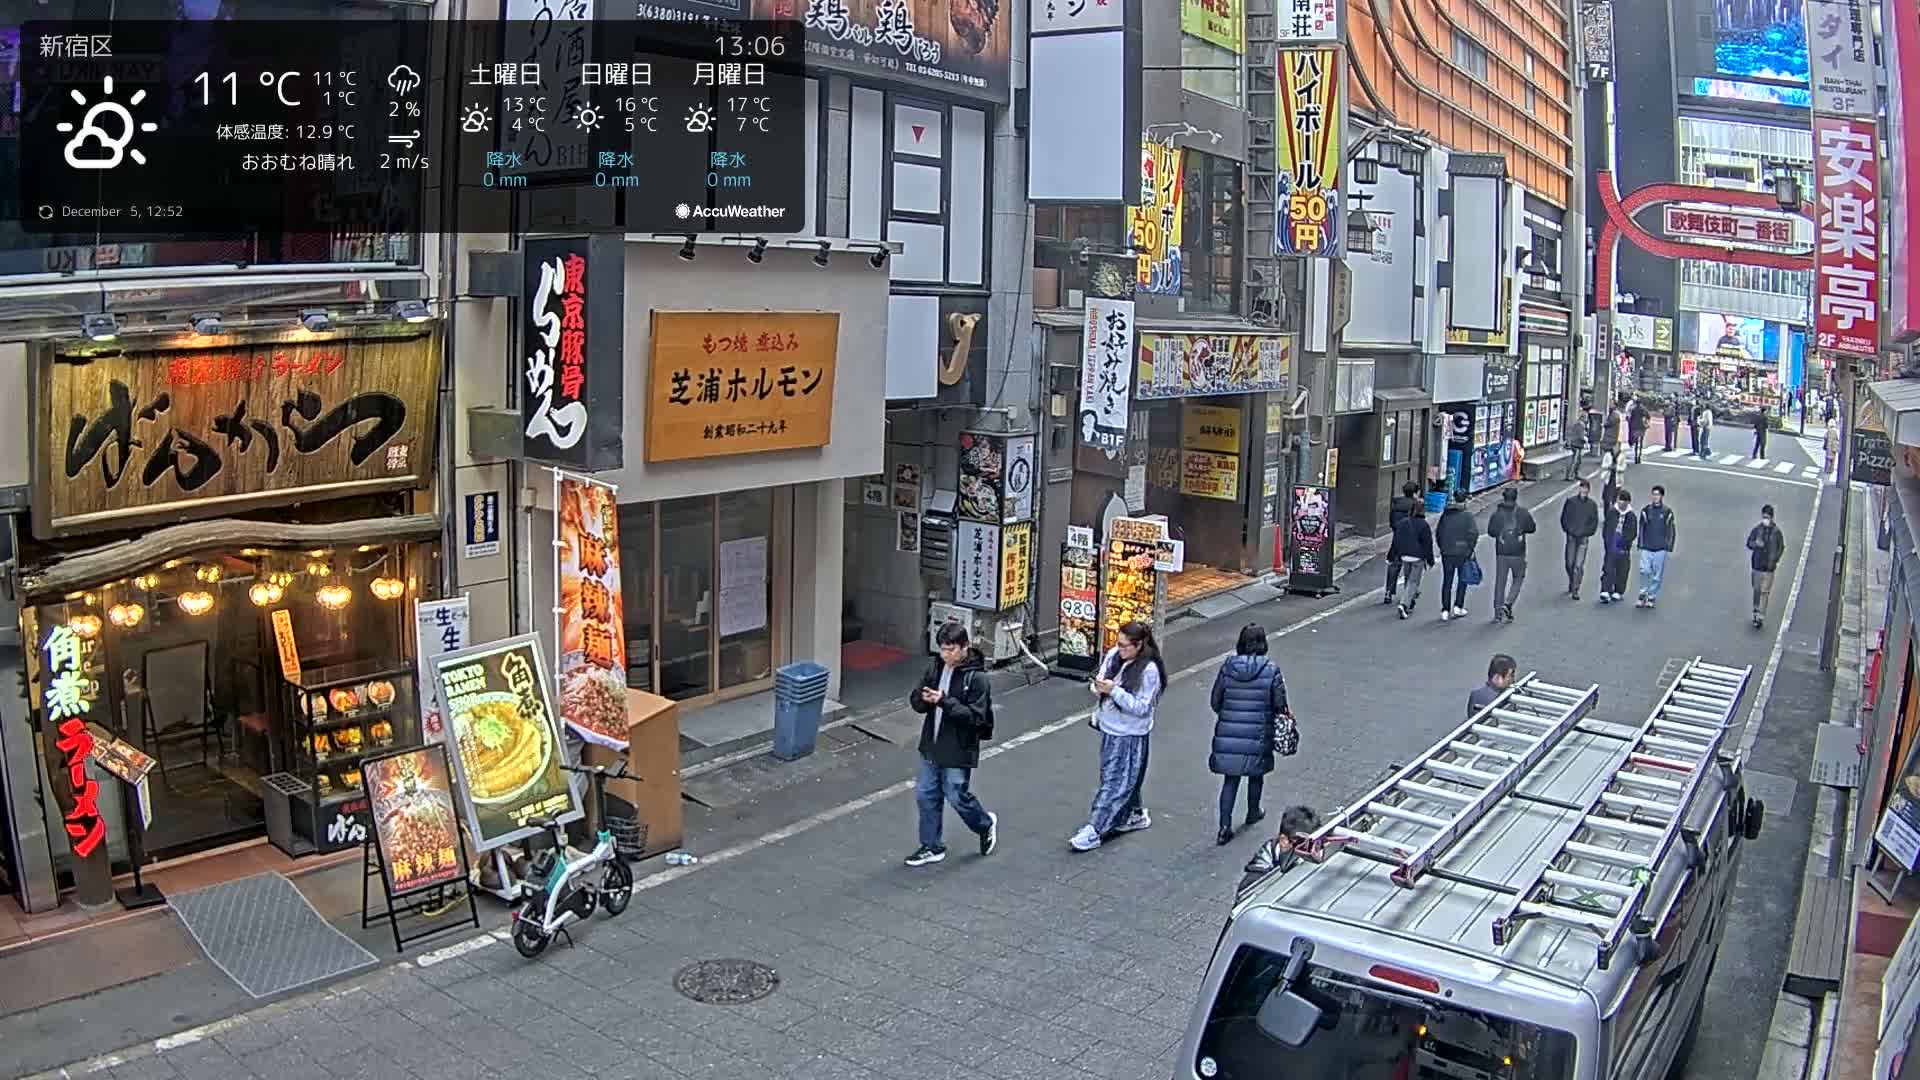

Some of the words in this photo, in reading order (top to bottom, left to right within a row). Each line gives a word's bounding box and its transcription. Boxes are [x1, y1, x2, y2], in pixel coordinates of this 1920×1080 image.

[1589, 63, 1609, 78] 7F
[1833, 96, 1855, 111] 3F
[1294, 51, 1322, 191] ハイボール
[1289, 195, 1328, 221] 50
[1134, 219, 1157, 250] 50
[1294, 224, 1320, 250] 円
[1670, 211, 1790, 242] 歌舞伎町一番街
[1819, 126, 1874, 330] 安楽亭
[560, 252, 585, 401] 東京豚骨
[1818, 332, 1837, 347] 2F
[1100, 308, 1128, 415] お好み焼き
[669, 365, 824, 406] 芝浦ホルモン
[1100, 434, 1124, 447] B1F
[441, 664, 485, 684] TOKYO
